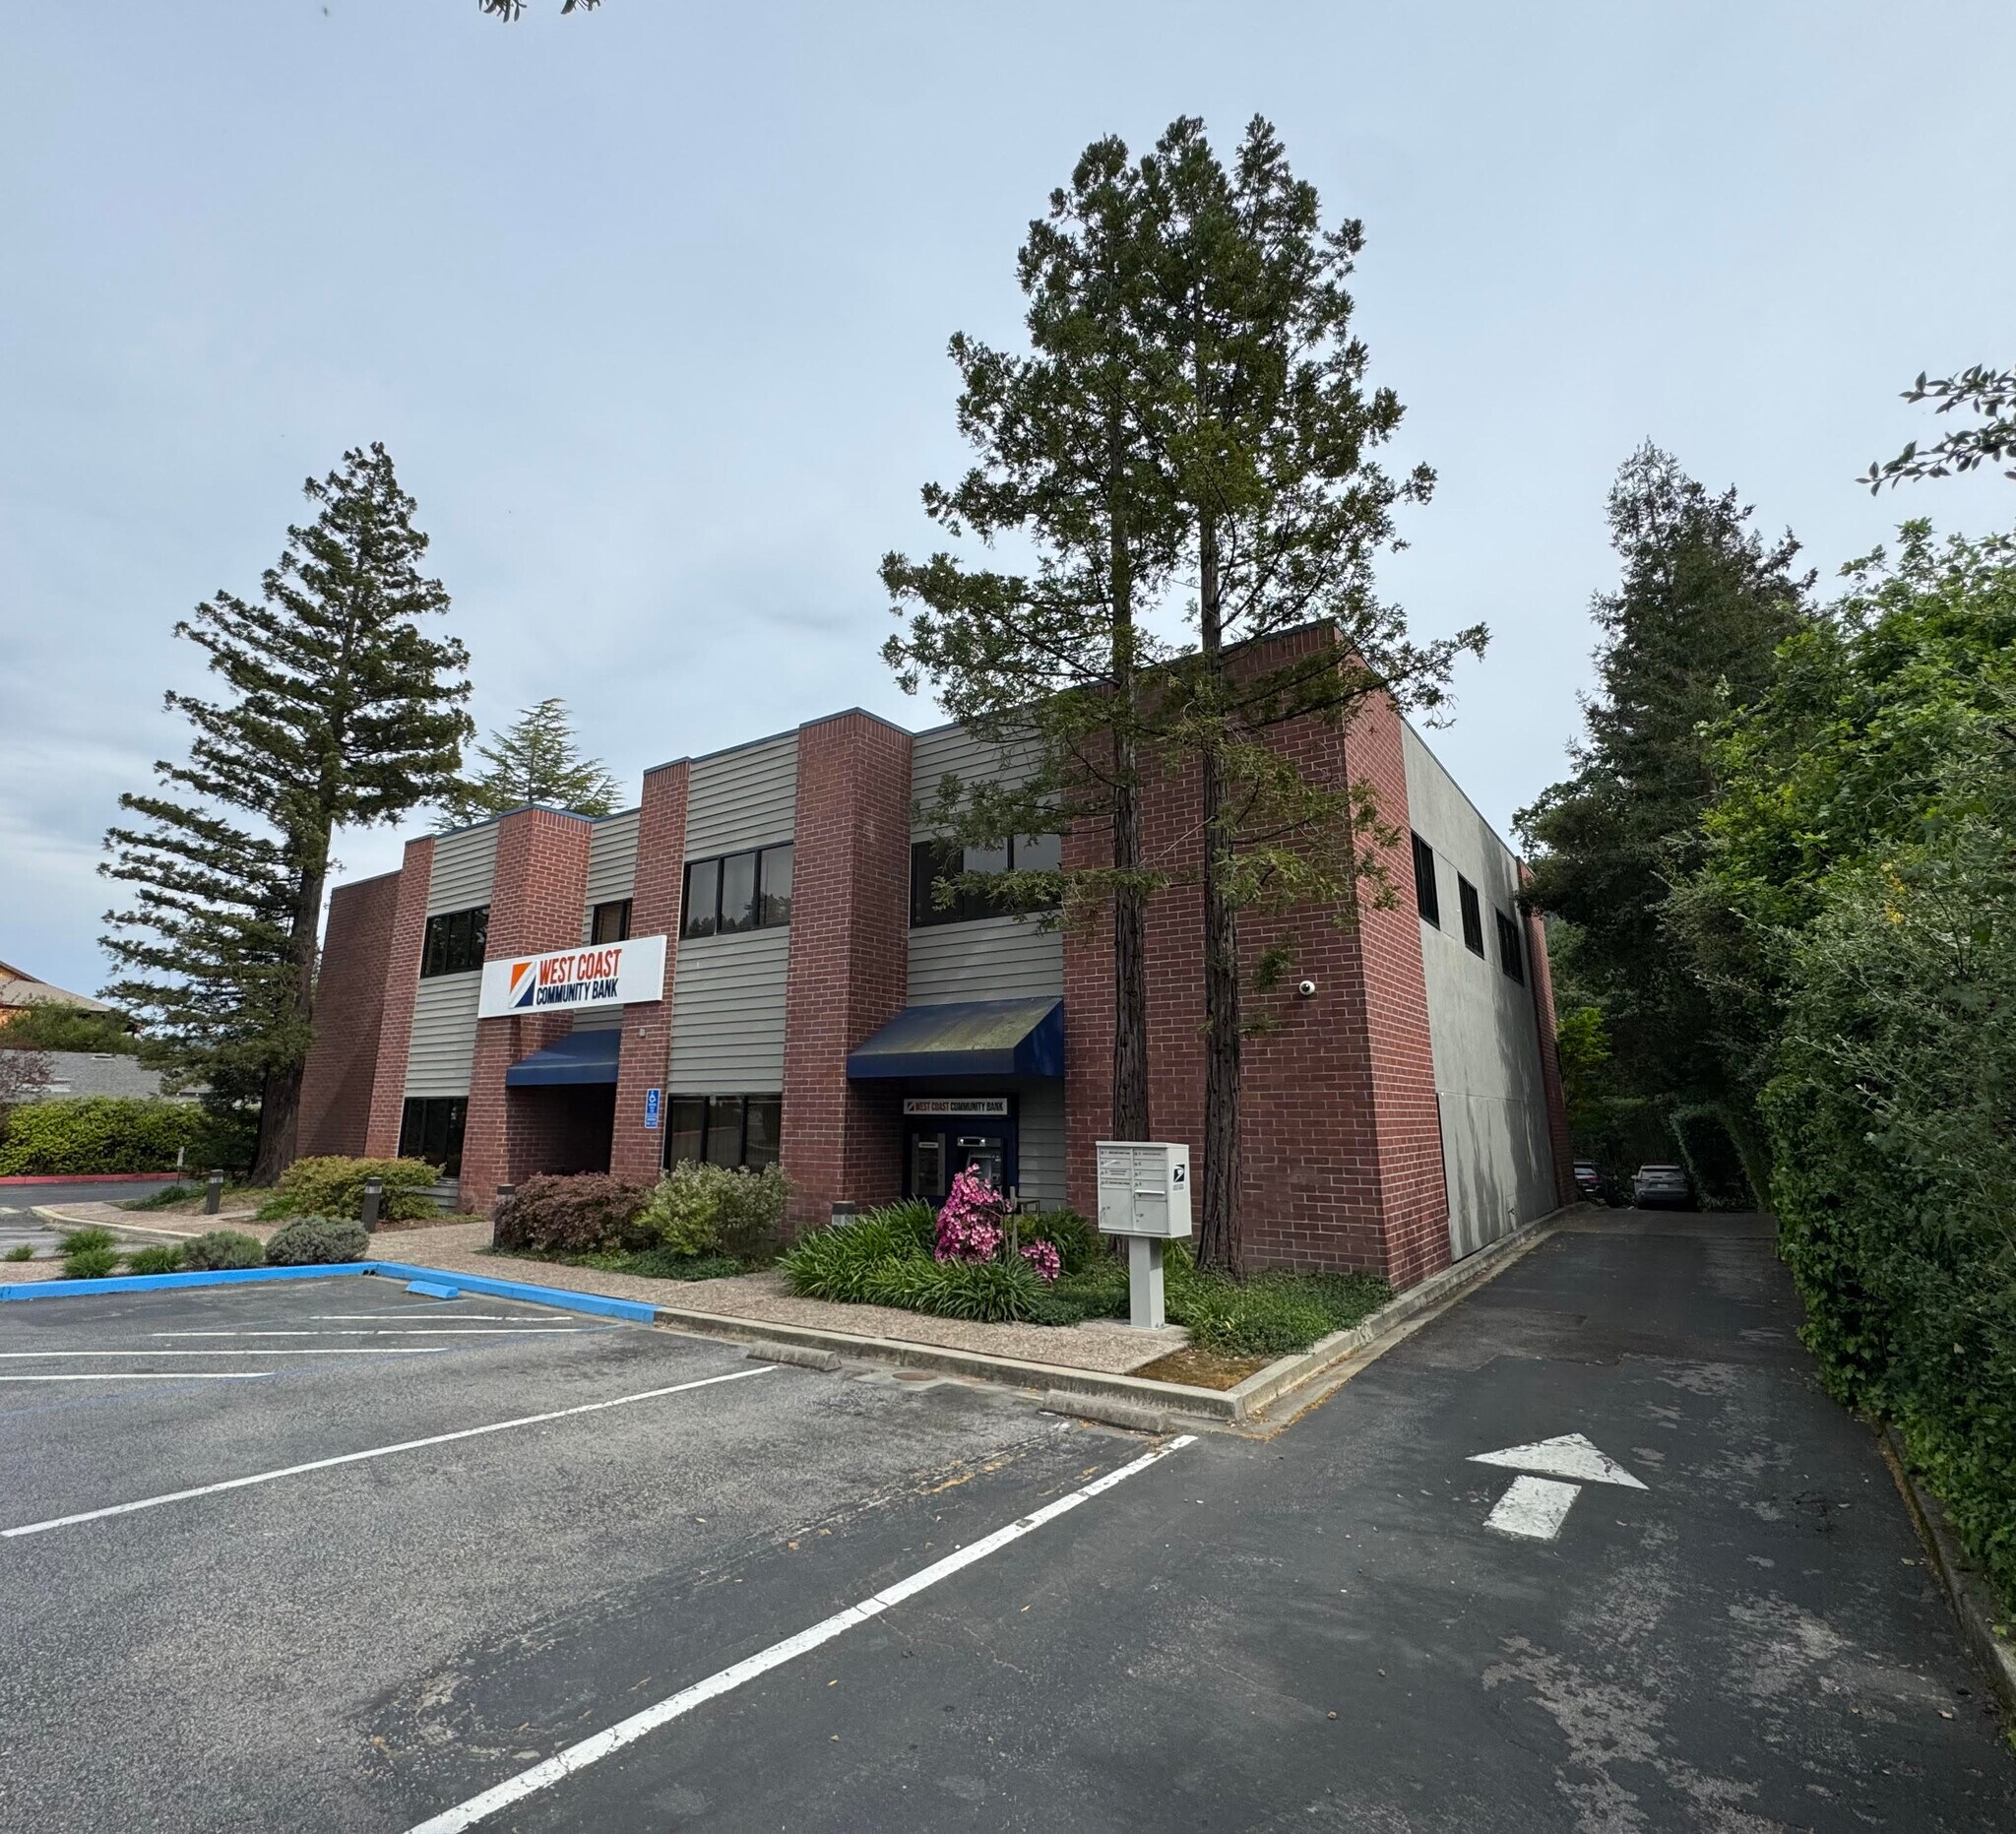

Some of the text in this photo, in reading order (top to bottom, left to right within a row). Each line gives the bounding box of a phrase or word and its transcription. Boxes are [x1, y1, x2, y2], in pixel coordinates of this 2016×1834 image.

[539, 949, 622, 985] WEST COAST
[536, 979, 619, 1005] COMMUNITY BANK
[915, 1102, 1004, 1111] WEST COAST COMMUNITY BANK
